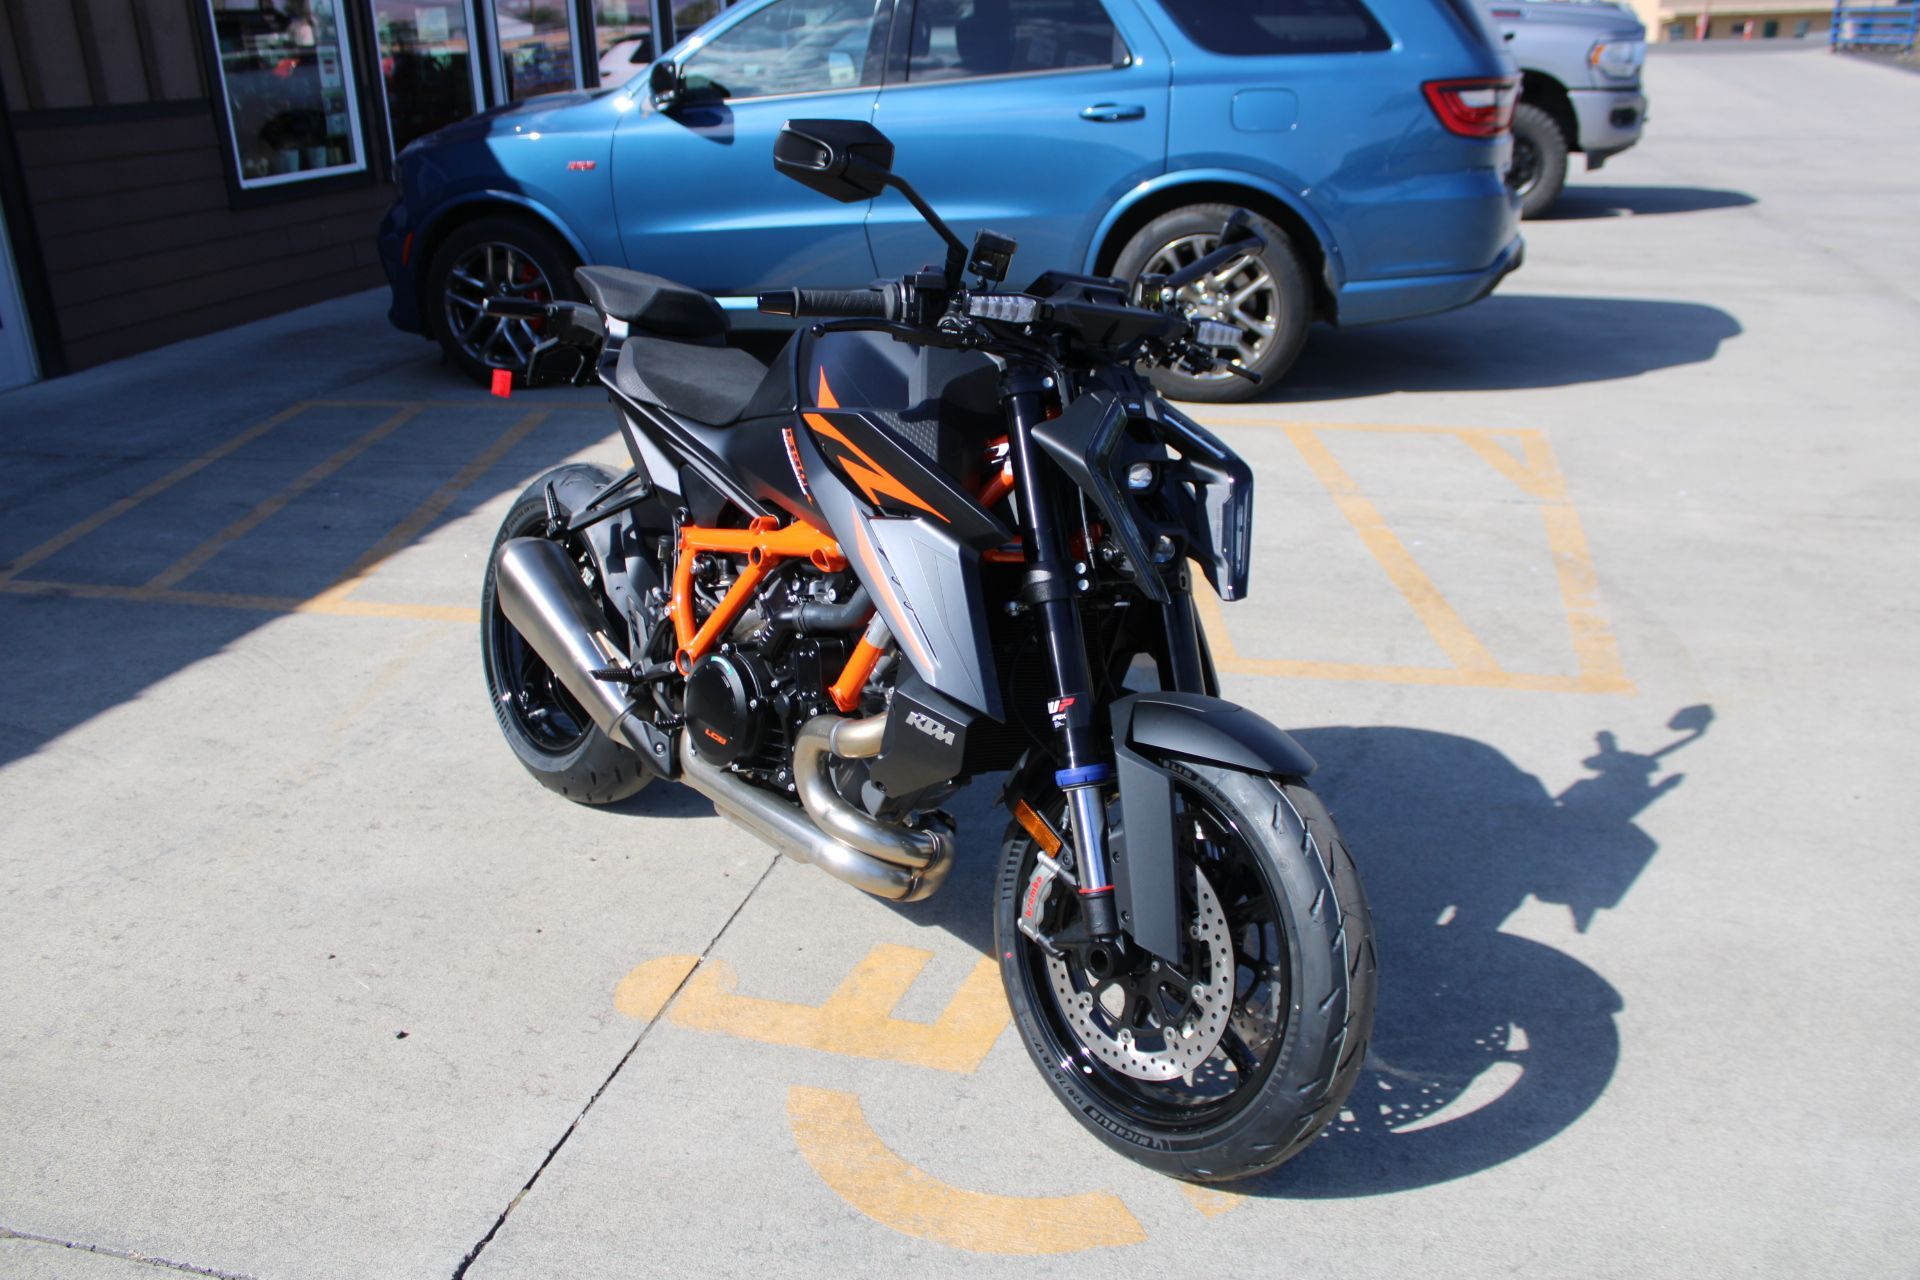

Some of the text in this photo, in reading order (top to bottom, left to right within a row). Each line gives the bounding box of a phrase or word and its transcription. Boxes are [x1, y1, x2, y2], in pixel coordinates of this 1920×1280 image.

[905, 711, 955, 746] KTM
[1024, 876, 1043, 918] brembo
[1043, 1056, 1056, 1071] ZR
[1054, 1073, 1083, 1106] 120/70
[1088, 1108, 1151, 1146] MICHELIN
